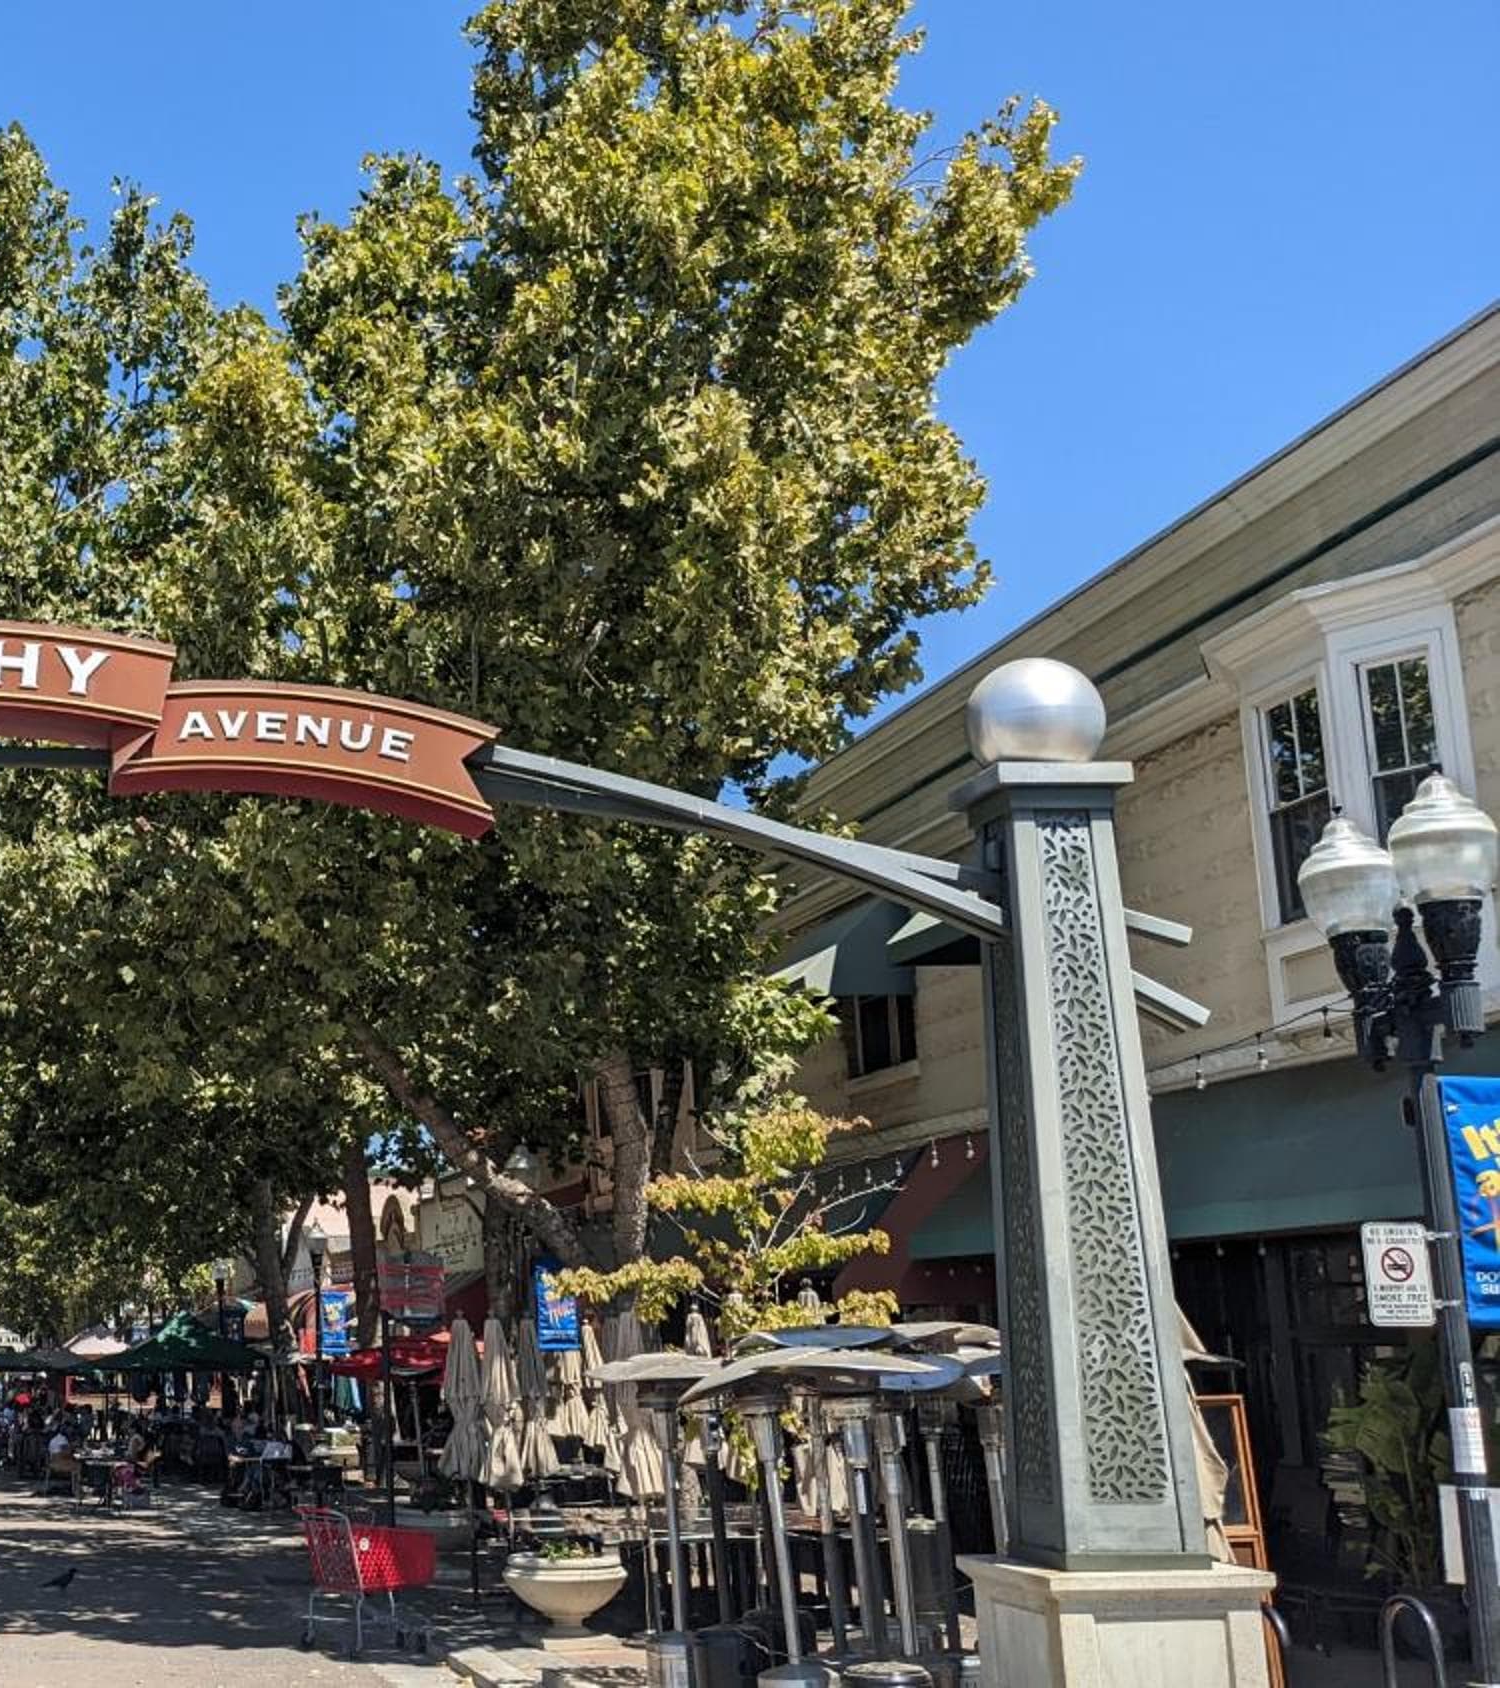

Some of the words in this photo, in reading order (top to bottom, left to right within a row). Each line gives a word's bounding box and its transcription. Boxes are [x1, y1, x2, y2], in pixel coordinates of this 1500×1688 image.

[177, 710, 416, 763] AVENUE
[1374, 1293, 1403, 1302] SMOKE
[1407, 1293, 1429, 1302] FREE
